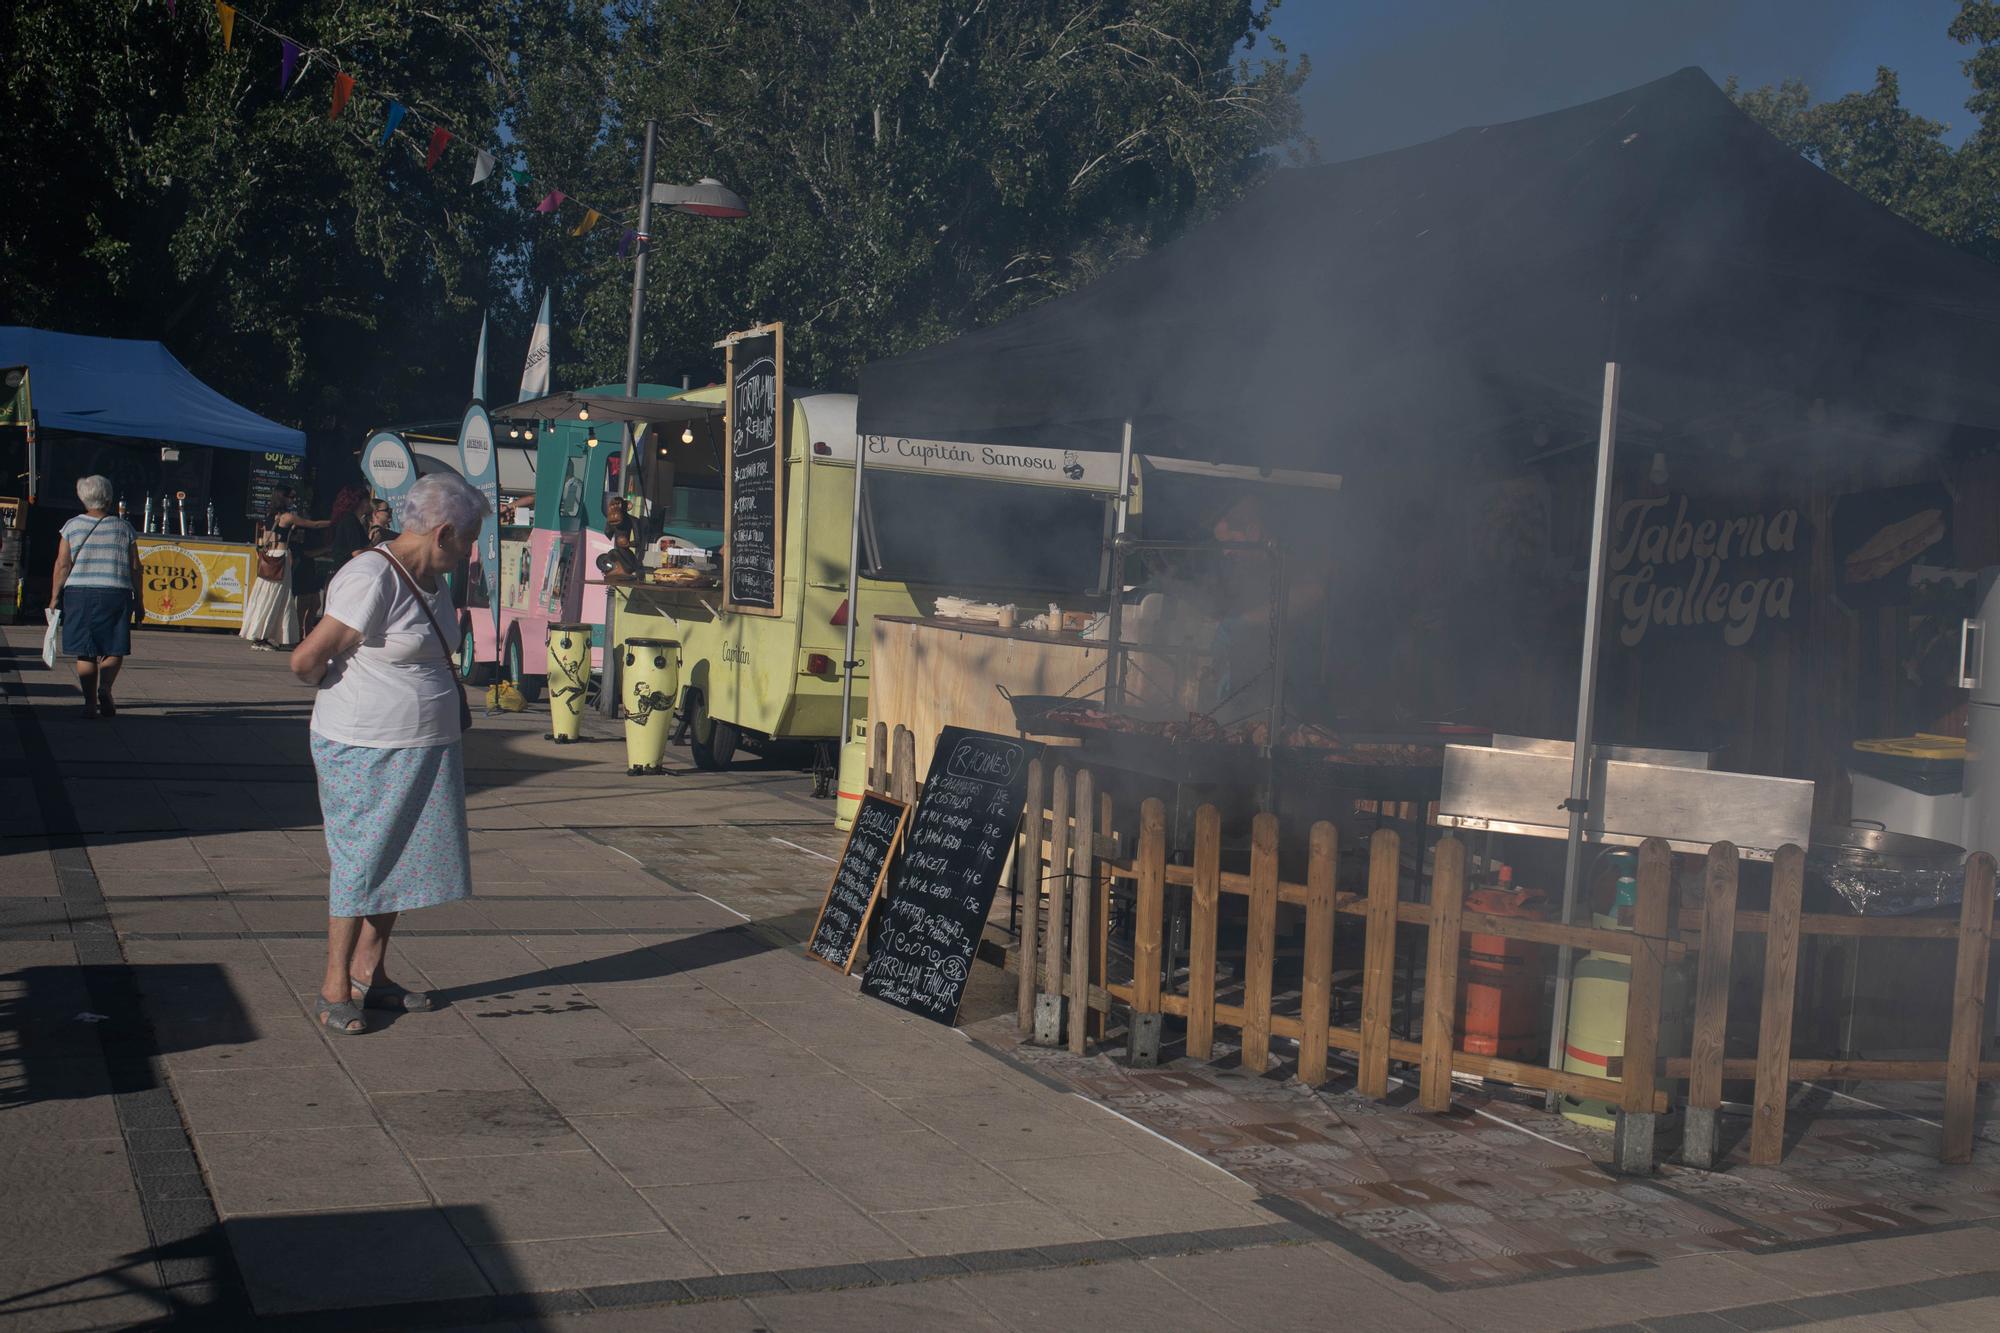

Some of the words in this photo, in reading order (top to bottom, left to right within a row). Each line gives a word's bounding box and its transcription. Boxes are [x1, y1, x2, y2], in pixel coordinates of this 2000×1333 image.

[868, 435, 889, 454] El
[897, 438, 975, 466] Capitán
[982, 447, 1057, 471] Samosa
[1610, 494, 1799, 572] Taberna
[144, 565, 198, 578] RUBIA
[148, 576, 198, 592] GO!
[1609, 556, 1794, 647] Gallega
[722, 640, 750, 671] Capitán
[986, 801, 1006, 817] 15€
[977, 840, 996, 860] 14€
[913, 851, 949, 875] PANCETA
[962, 867, 982, 885] 14€
[963, 895, 980, 914] 15€
[962, 937, 973, 957] 7€
[922, 966, 959, 1007] FAMILIAR
